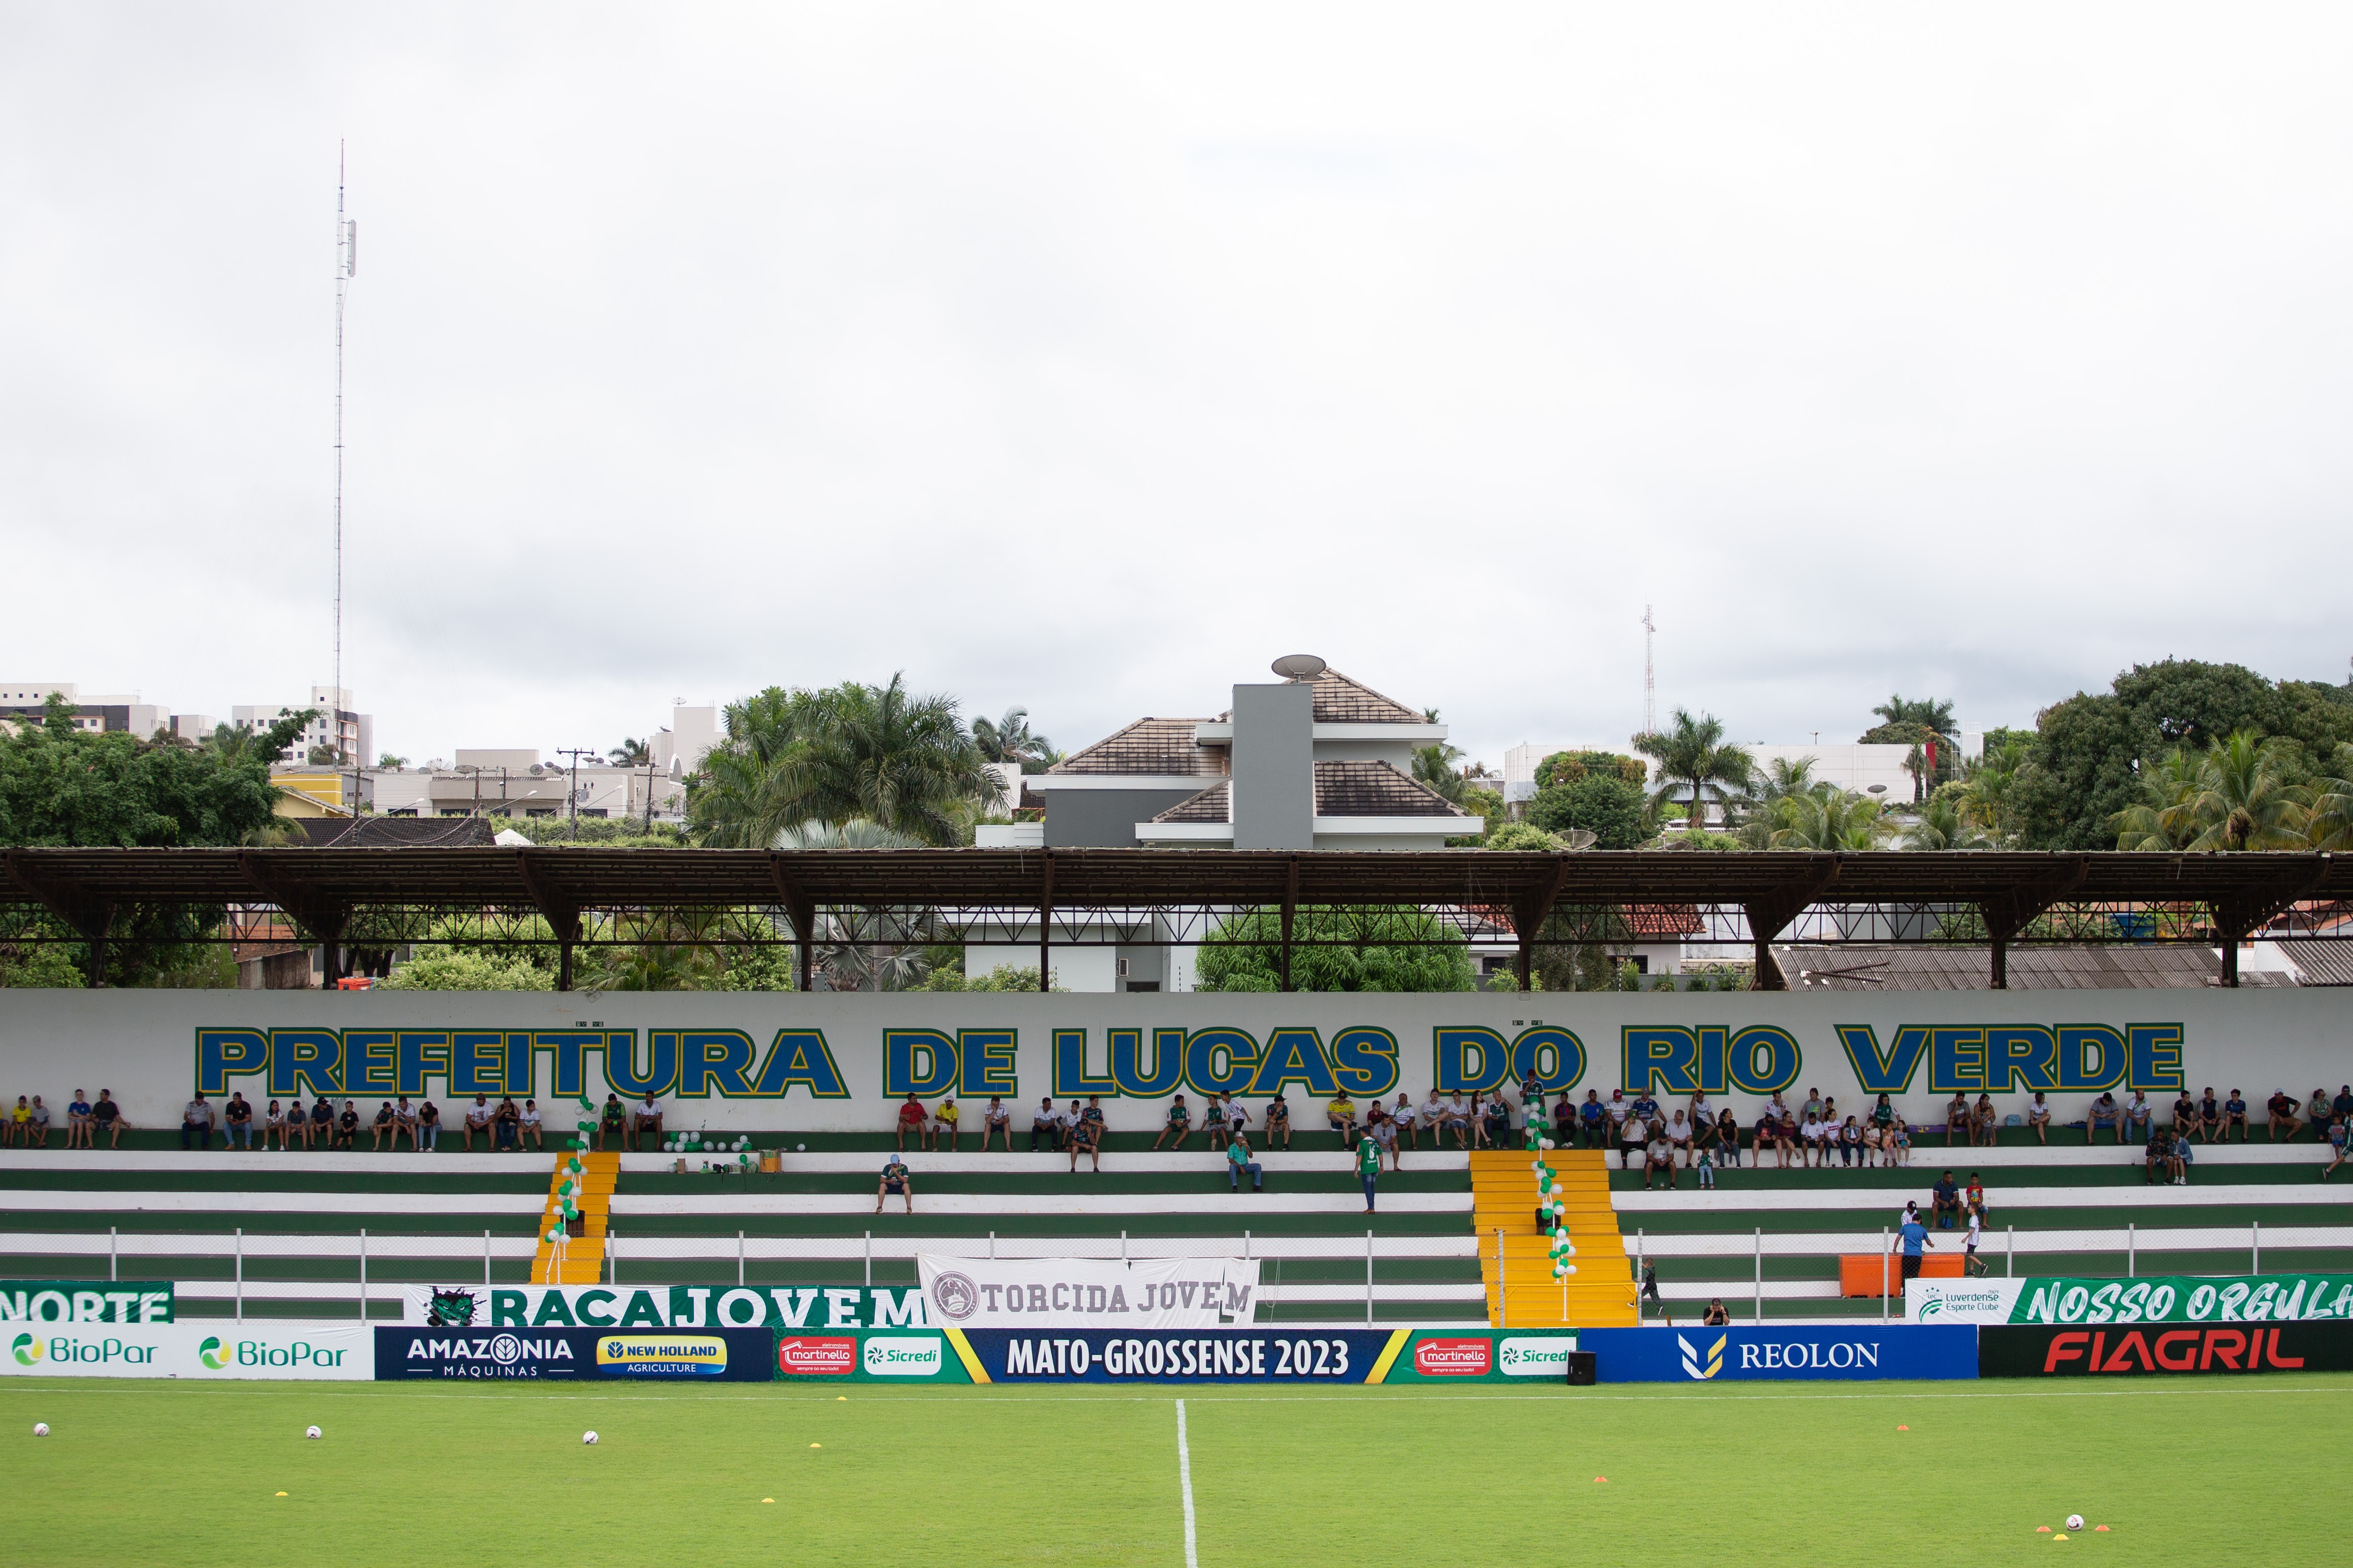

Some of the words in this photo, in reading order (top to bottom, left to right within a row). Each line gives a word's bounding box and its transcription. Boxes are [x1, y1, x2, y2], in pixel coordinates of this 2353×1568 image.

[195, 1027, 851, 1099] PREFEITURA
[883, 1028, 1018, 1098] DE
[1052, 1025, 1399, 1098] LUCAS
[1433, 1025, 1587, 1096] DO
[1621, 1024, 1802, 1096] RIO
[1833, 1022, 2184, 1094] VERDE
[0, 1290, 169, 1323] NORTE
[981, 1283, 1129, 1313] TORCIDA
[1137, 1281, 1251, 1313] JOVEM
[1946, 1293, 1999, 1302] Luverdense
[2027, 1282, 2175, 1323] NOSSO
[1946, 1303, 1975, 1312] Esporte
[51, 1338, 158, 1363] BioPar
[238, 1341, 348, 1366] BioPar
[628, 1346, 656, 1356] NEW
[659, 1346, 717, 1356] HOLLAND
[793, 1350, 850, 1360] martinello
[887, 1350, 937, 1362] Sicredi
[1006, 1339, 1265, 1376] MATO-GROSSENSE
[1273, 1339, 1349, 1376] 2023
[1428, 1350, 1485, 1361] martinello
[1522, 1350, 1572, 1362] Sicred
[1739, 1343, 1880, 1369] REOLON
[2043, 1328, 2304, 1373] FIAGRIL
[444, 1364, 538, 1377] MÁQUINAS
[628, 1364, 696, 1372] AGRICULTURE
